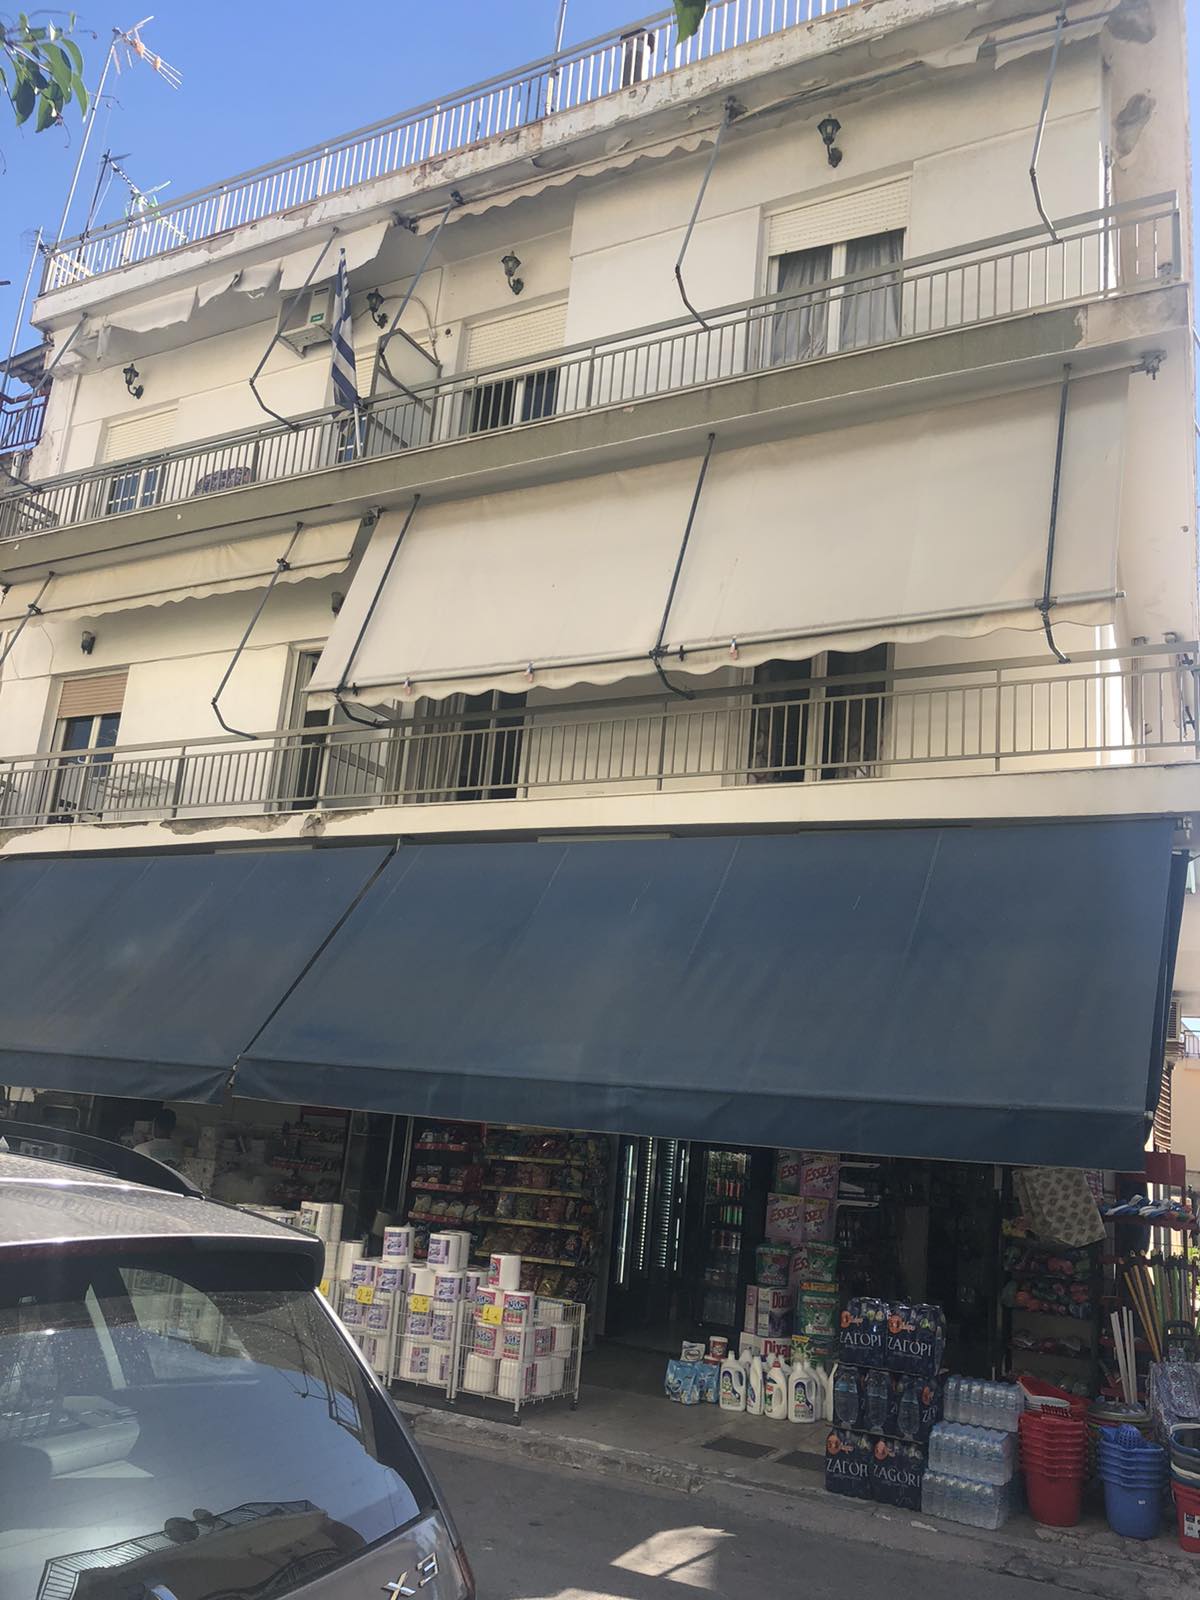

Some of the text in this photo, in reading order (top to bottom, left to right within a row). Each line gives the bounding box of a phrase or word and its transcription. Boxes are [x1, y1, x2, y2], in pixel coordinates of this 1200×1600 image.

[772, 1291, 793, 1309] Dixa
[763, 1340, 792, 1358] Dixa
[887, 1336, 932, 1357] ΖΑΓΟΡΙ
[873, 1464, 921, 1488] ZAGORI
